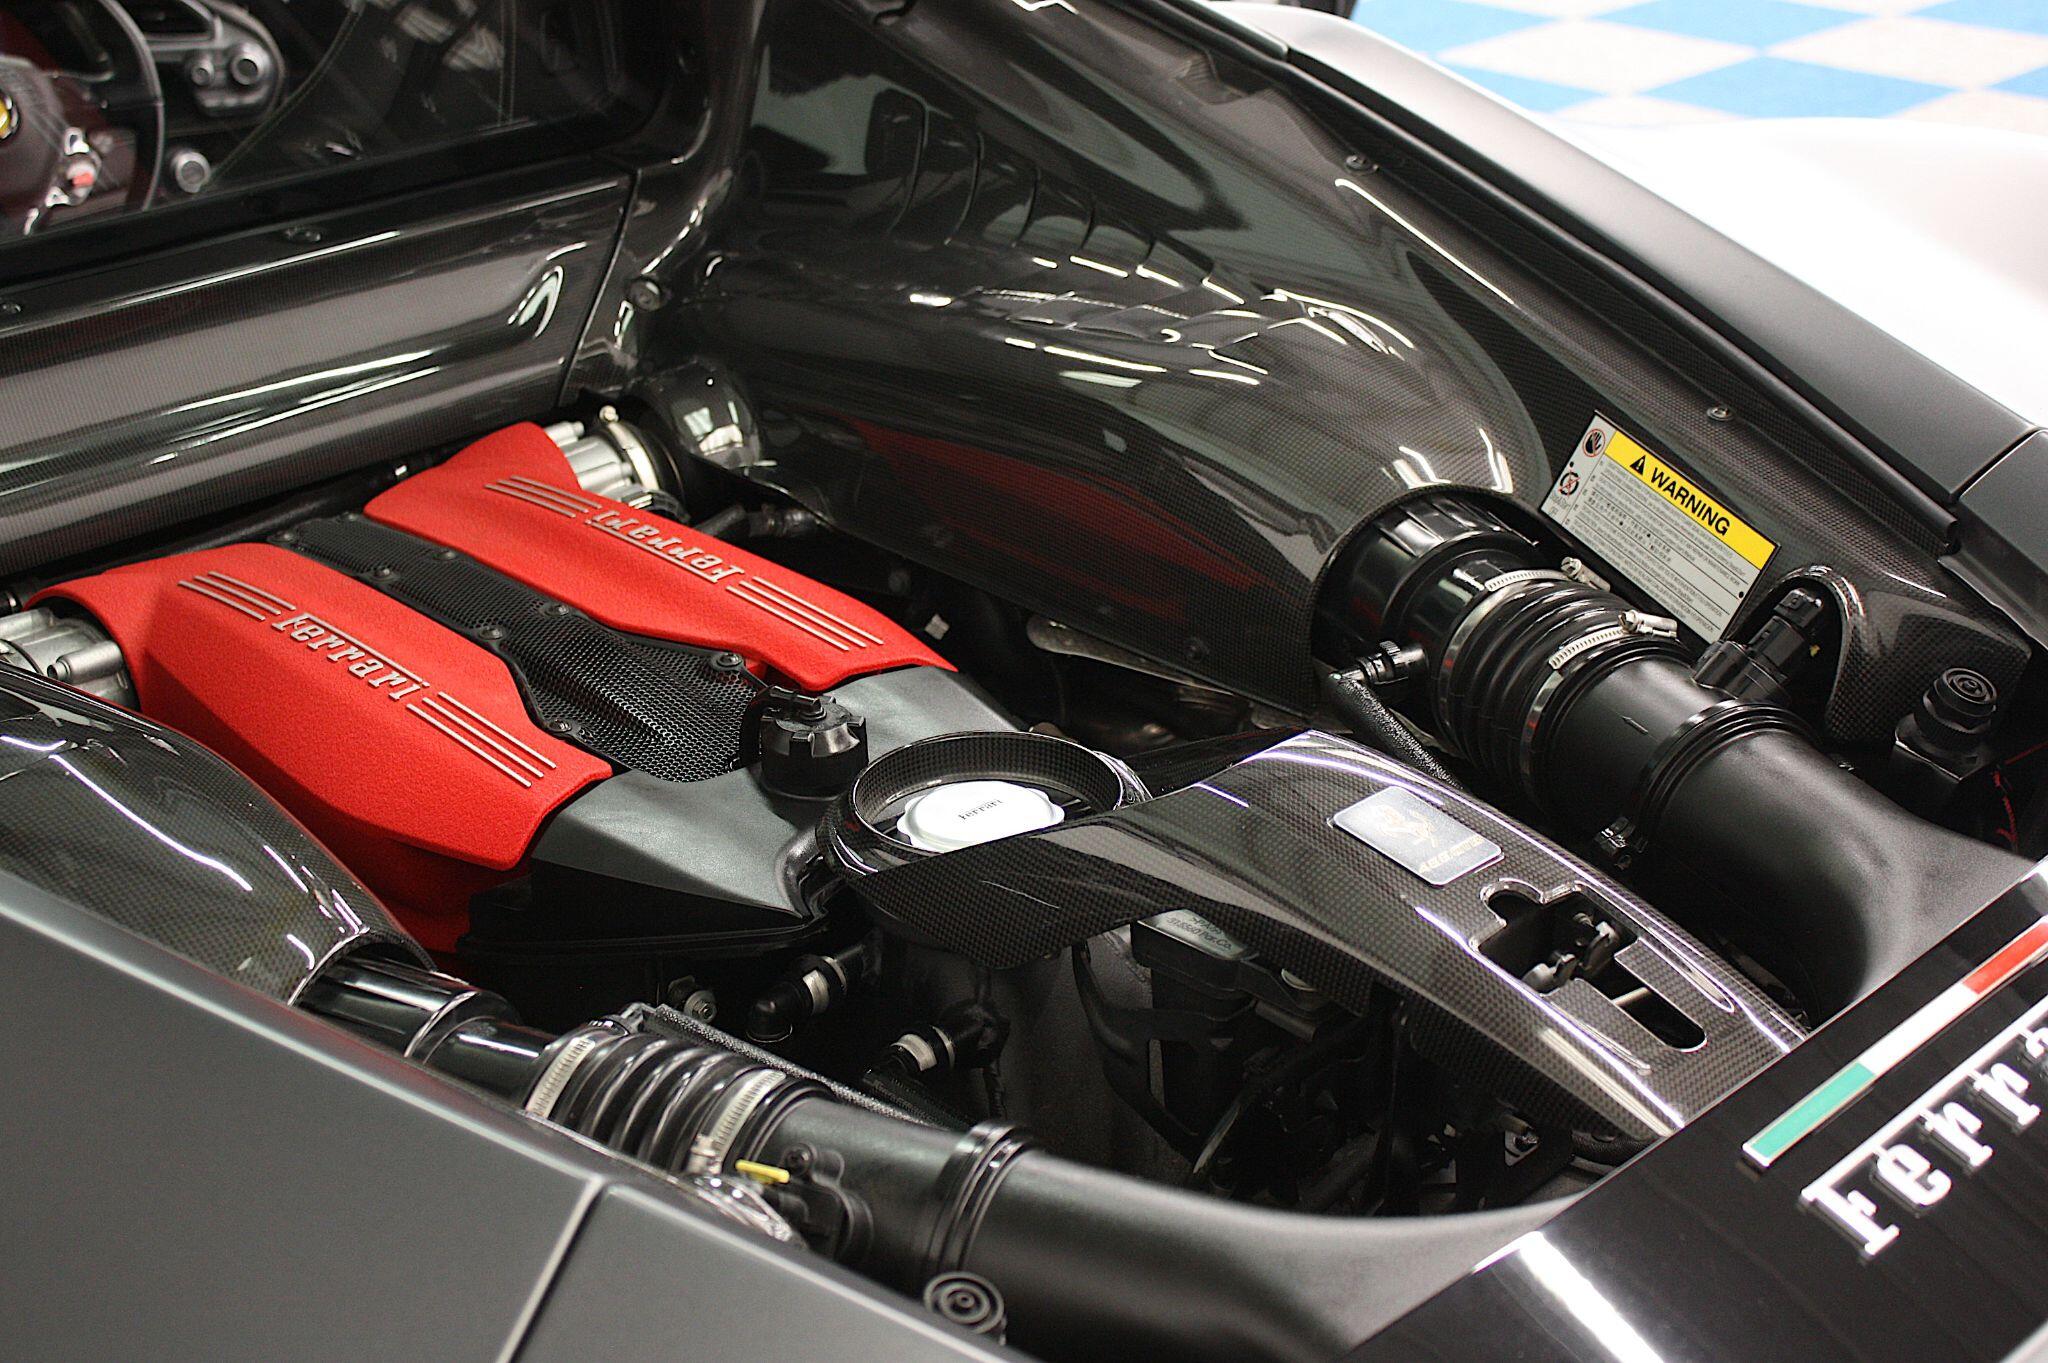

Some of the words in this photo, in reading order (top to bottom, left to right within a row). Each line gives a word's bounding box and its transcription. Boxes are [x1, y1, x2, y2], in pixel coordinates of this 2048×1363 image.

[1650, 467, 1730, 536] WARNING
[585, 510, 745, 583] Ferrari
[271, 612, 430, 701] Ferrari
[1801, 994, 2048, 1256] Ferr
